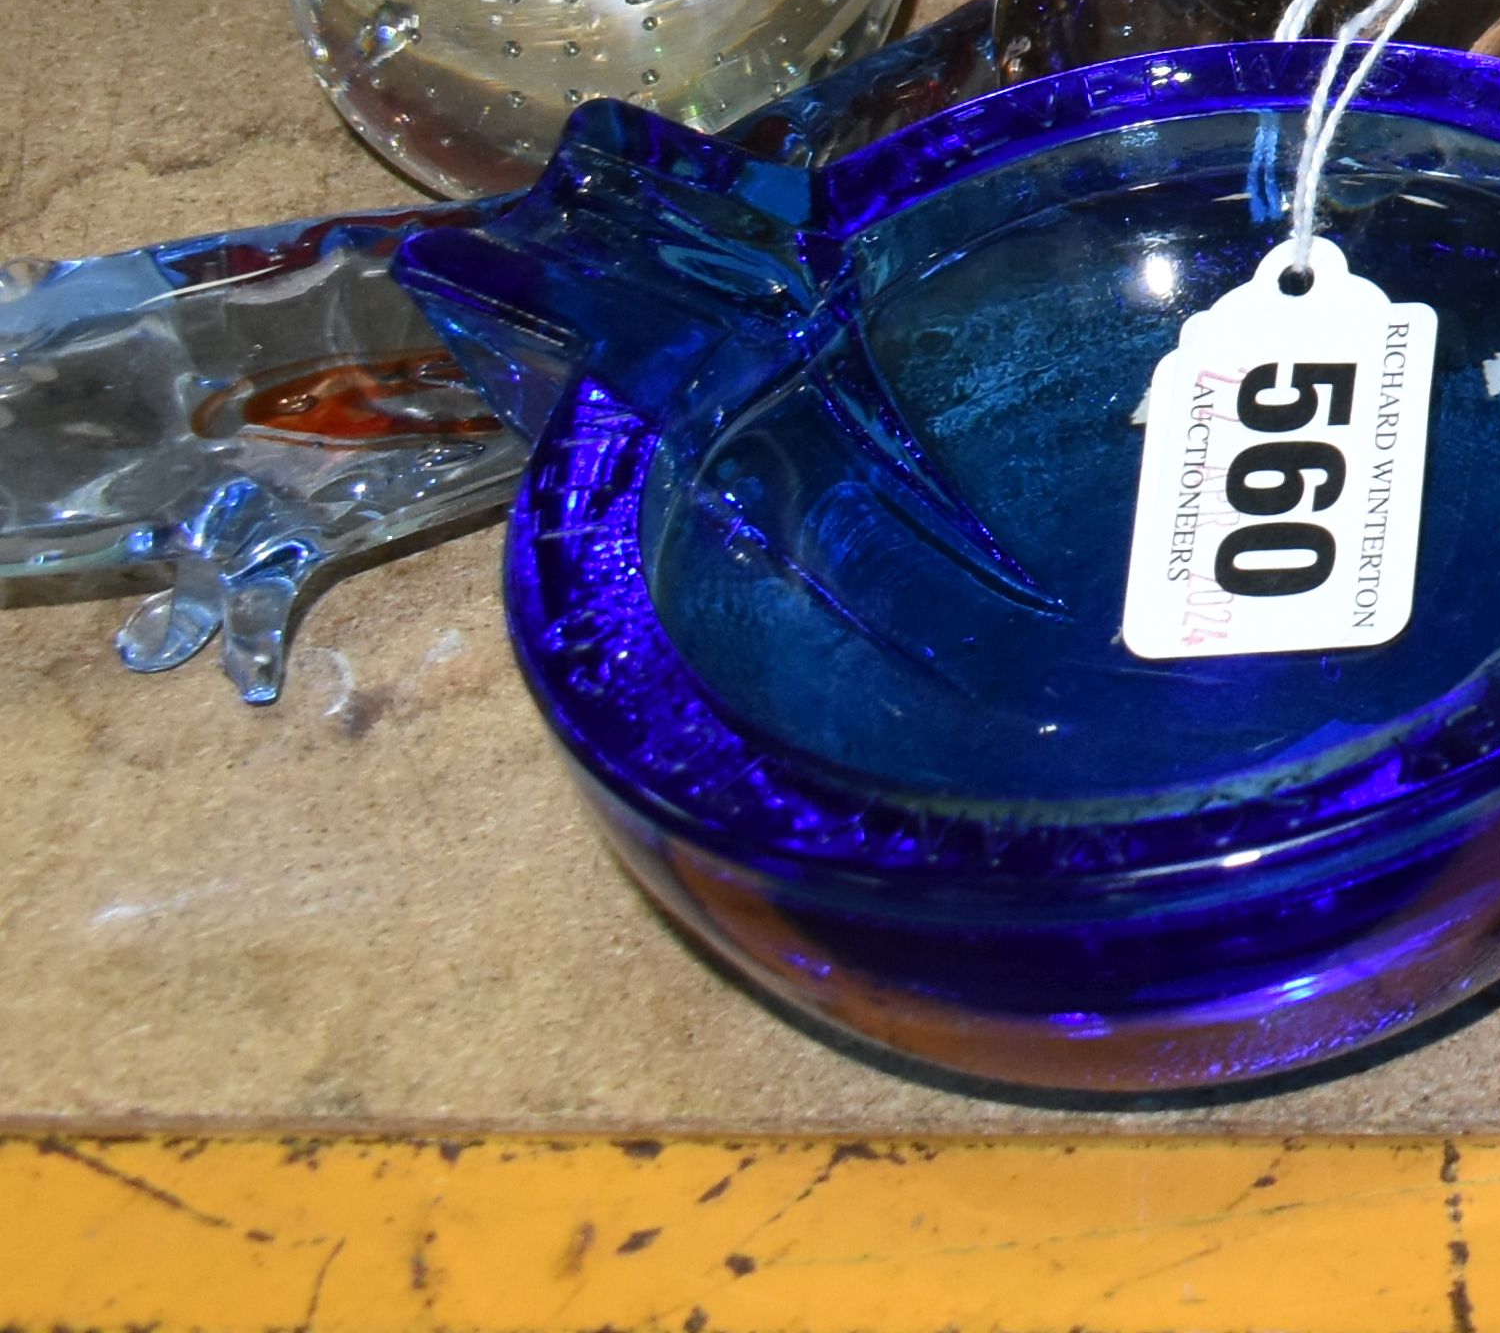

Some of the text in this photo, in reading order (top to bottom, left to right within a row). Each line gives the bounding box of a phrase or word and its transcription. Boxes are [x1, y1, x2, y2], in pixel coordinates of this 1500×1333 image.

[1167, 381, 1215, 583] AUCTIONEERS
[1214, 362, 1358, 597] 560
[1353, 322, 1411, 629] RICHARD WINTERTON
